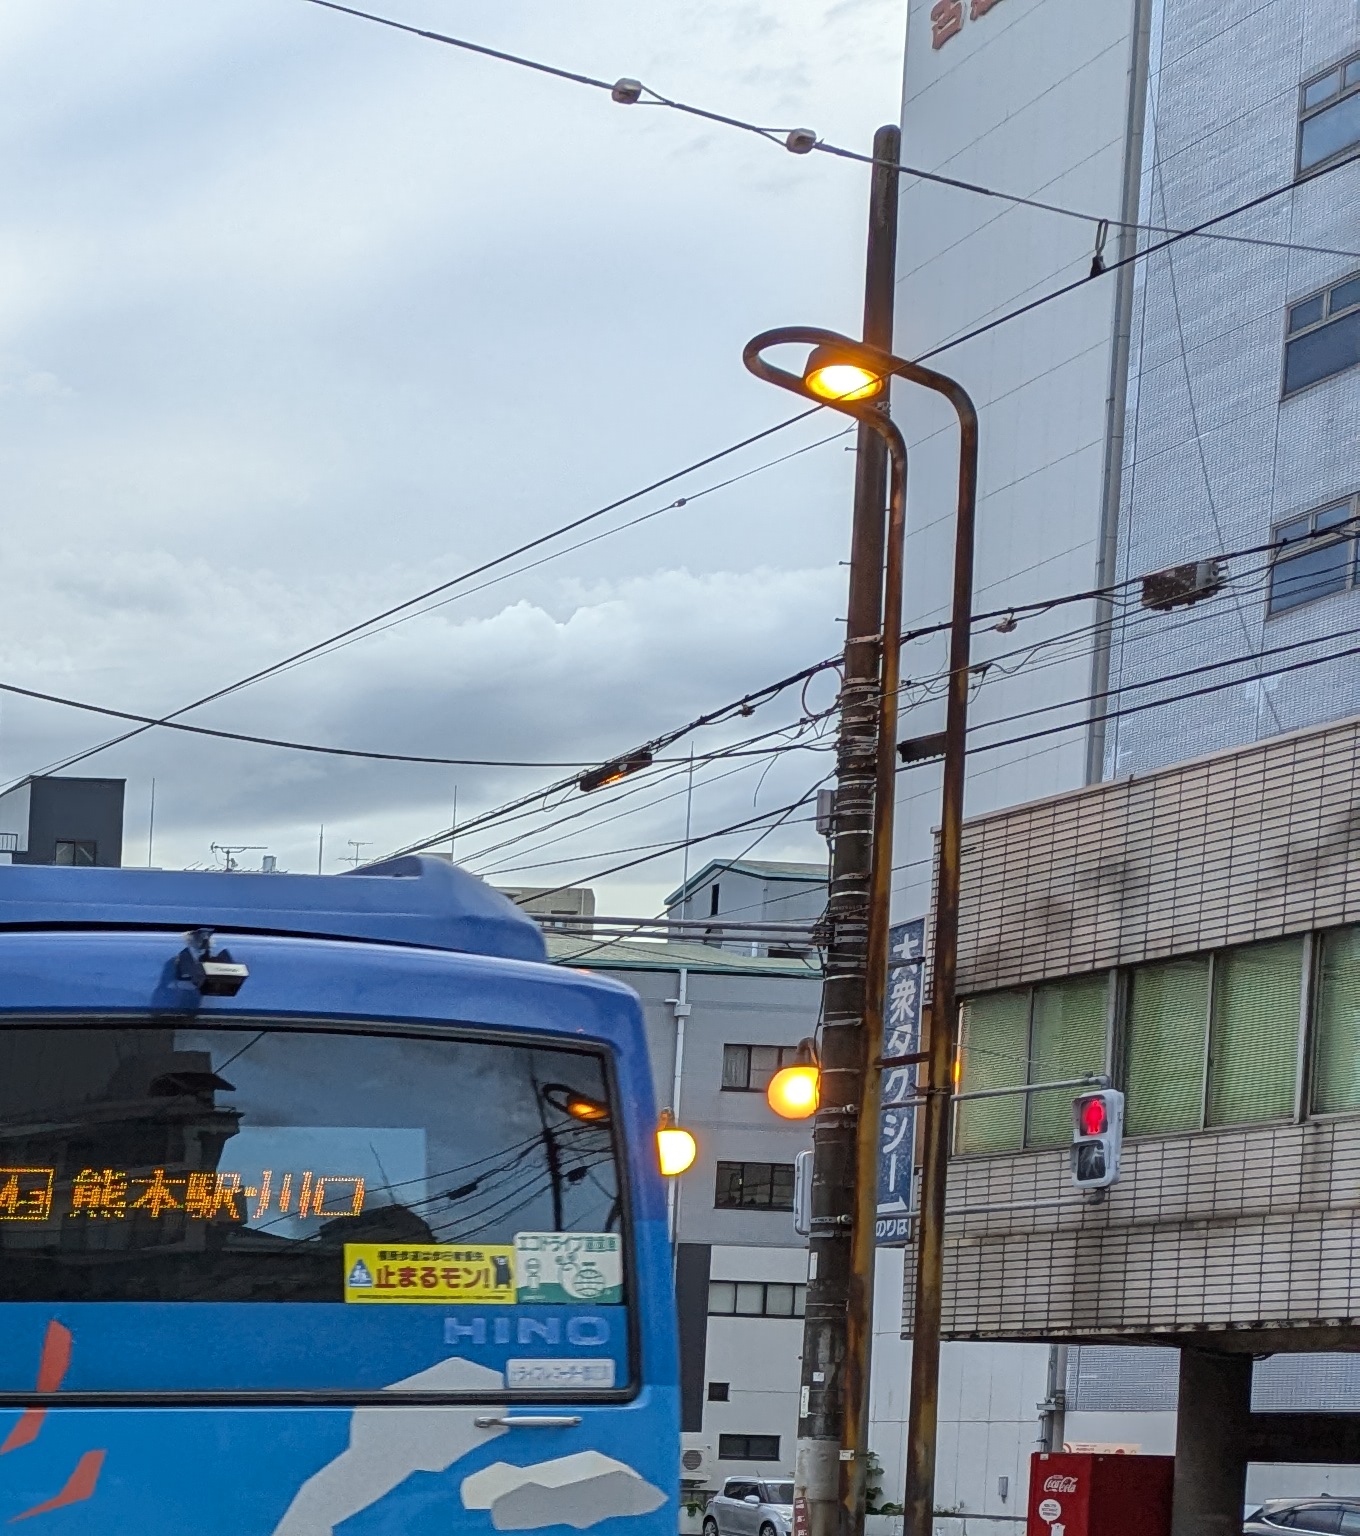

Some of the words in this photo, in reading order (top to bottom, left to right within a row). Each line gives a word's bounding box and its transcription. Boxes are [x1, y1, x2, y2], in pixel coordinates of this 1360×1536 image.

[882, 933, 919, 1192] 大衆タクシー
[443, 1316, 611, 1346] HINO
